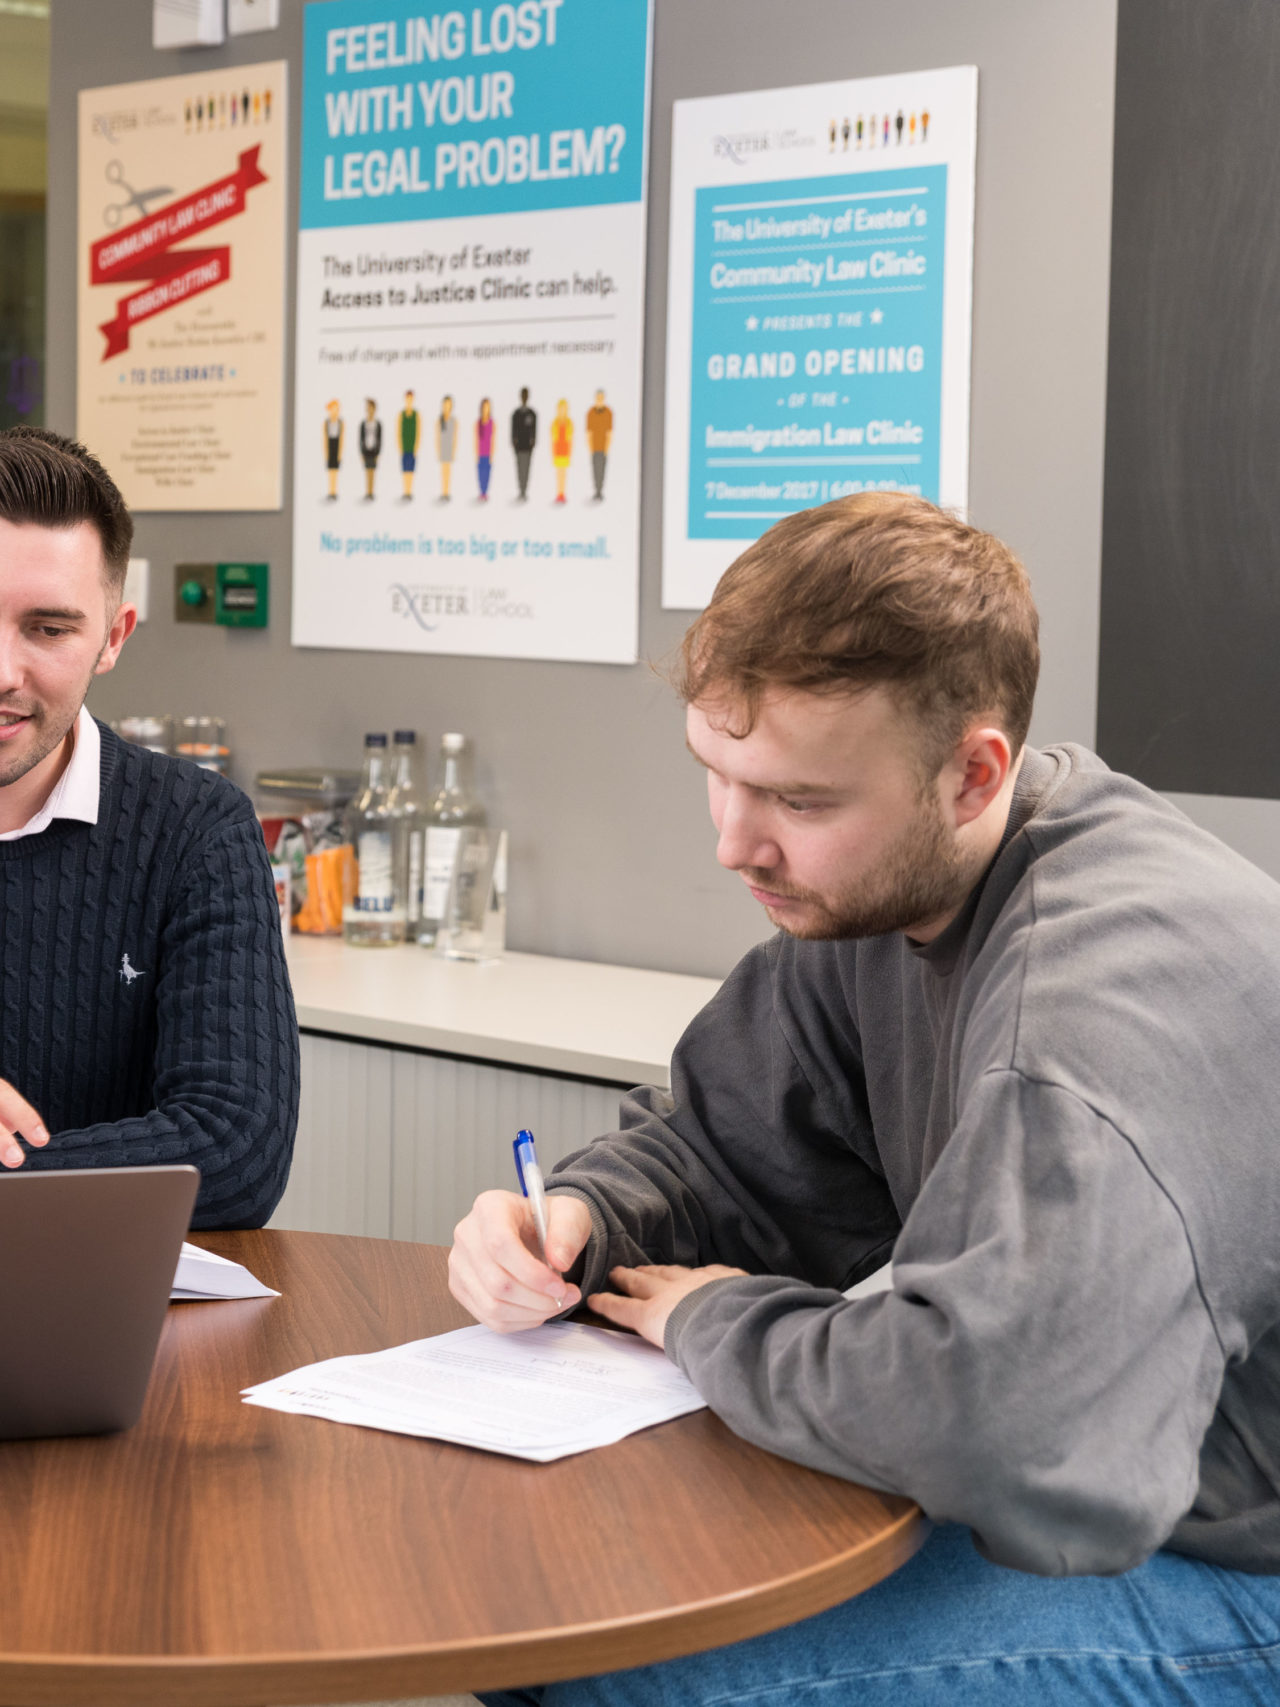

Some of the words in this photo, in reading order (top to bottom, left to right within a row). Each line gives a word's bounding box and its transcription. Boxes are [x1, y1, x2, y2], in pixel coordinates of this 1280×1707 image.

[326, 11, 466, 75] FEELING
[471, 0, 564, 56] LOST
[325, 83, 413, 138] WITH
[418, 71, 514, 127] YOUR
[324, 147, 430, 200] LEGAL
[434, 124, 626, 190] PROBLEM?
[98, 218, 167, 270] COMMUNITY
[167, 204, 195, 236] LAW
[195, 183, 236, 222] CLINIC
[713, 218, 744, 242] The
[745, 213, 831, 239] University
[833, 208, 852, 234] of
[854, 203, 926, 231] Exeter's
[169, 258, 221, 300] CUTTING
[322, 256, 351, 277] The
[357, 250, 445, 275] University
[450, 246, 468, 271] of
[472, 245, 531, 269] Exeter
[710, 258, 824, 289] Community
[826, 255, 867, 281] Law
[870, 249, 926, 278] Clinic
[320, 287, 383, 310] Access
[388, 286, 406, 307] to
[411, 280, 476, 306] Justice
[481, 275, 531, 301] Clinic
[535, 278, 569, 298] can
[573, 270, 618, 300] help.
[762, 312, 832, 331] PRESENTS
[837, 311, 863, 328] THE
[319, 348, 343, 363] Free
[348, 347, 358, 362] of
[362, 347, 399, 365] charge
[404, 346, 424, 362] and
[427, 343, 451, 360] with
[471, 342, 548, 361] appointment
[552, 339, 614, 357] necessary
[707, 351, 797, 380] GRAND
[804, 345, 924, 377] OPENING
[131, 367, 146, 384] TO
[150, 364, 225, 384] CELEBRATE
[787, 392, 808, 408] OF
[811, 391, 838, 407] THE
[705, 423, 820, 453] Immigration
[824, 421, 863, 446] Law
[866, 419, 923, 445] Clinic
[705, 481, 715, 499] 7
[716, 480, 781, 499] December
[782, 480, 819, 499] 2017
[320, 532, 342, 552] No
[346, 533, 415, 558] problem
[419, 533, 432, 554] is
[437, 535, 465, 555] too
[471, 533, 497, 561] big
[501, 538, 518, 557] or
[523, 535, 554, 557] too
[558, 535, 611, 559] small.
[388, 583, 469, 631] EXETER
